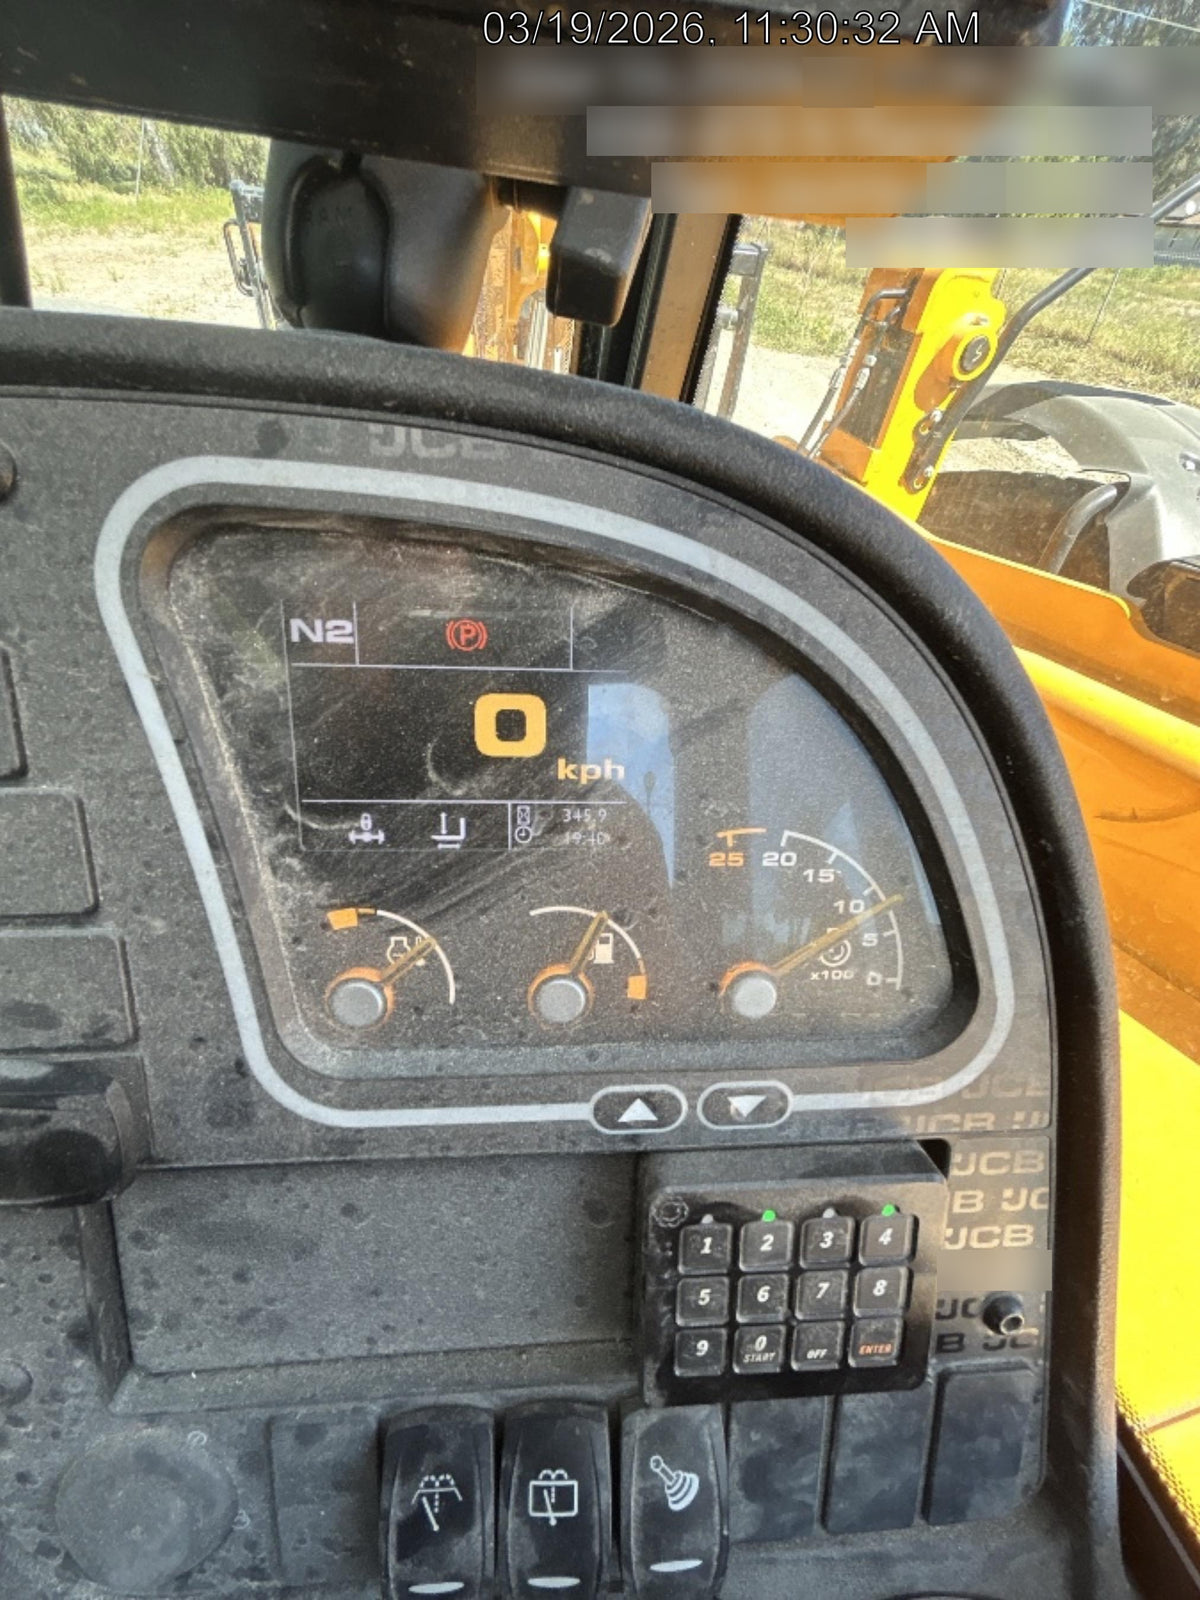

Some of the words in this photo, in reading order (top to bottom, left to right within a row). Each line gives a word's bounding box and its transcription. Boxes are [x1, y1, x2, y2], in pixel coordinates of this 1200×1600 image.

[290, 618, 355, 643] N2
[474, 693, 547, 758] 0
[557, 758, 625, 784] kph
[708, 852, 744, 867] 25
[762, 851, 797, 867] 20
[803, 868, 835, 883] 15
[833, 900, 865, 914] 10
[862, 933, 878, 947] 5
[866, 972, 882, 986] 0
[951, 1150, 1045, 1176] JCB
[760, 1234, 774, 1252] 2
[819, 1231, 835, 1249] 3
[878, 1228, 893, 1246] 4
[943, 1224, 1034, 1250] JCB
[700, 1237, 713, 1255] 1
[756, 1286, 770, 1303] 6
[815, 1283, 829, 1299] 7
[872, 1279, 888, 1297] 8
[697, 1288, 711, 1306] 5
[695, 1339, 709, 1357] 9
[754, 1335, 768, 1352] 0
[858, 1344, 892, 1355] ENTER
[743, 1352, 775, 1363] START
[806, 1349, 828, 1360] OFF
